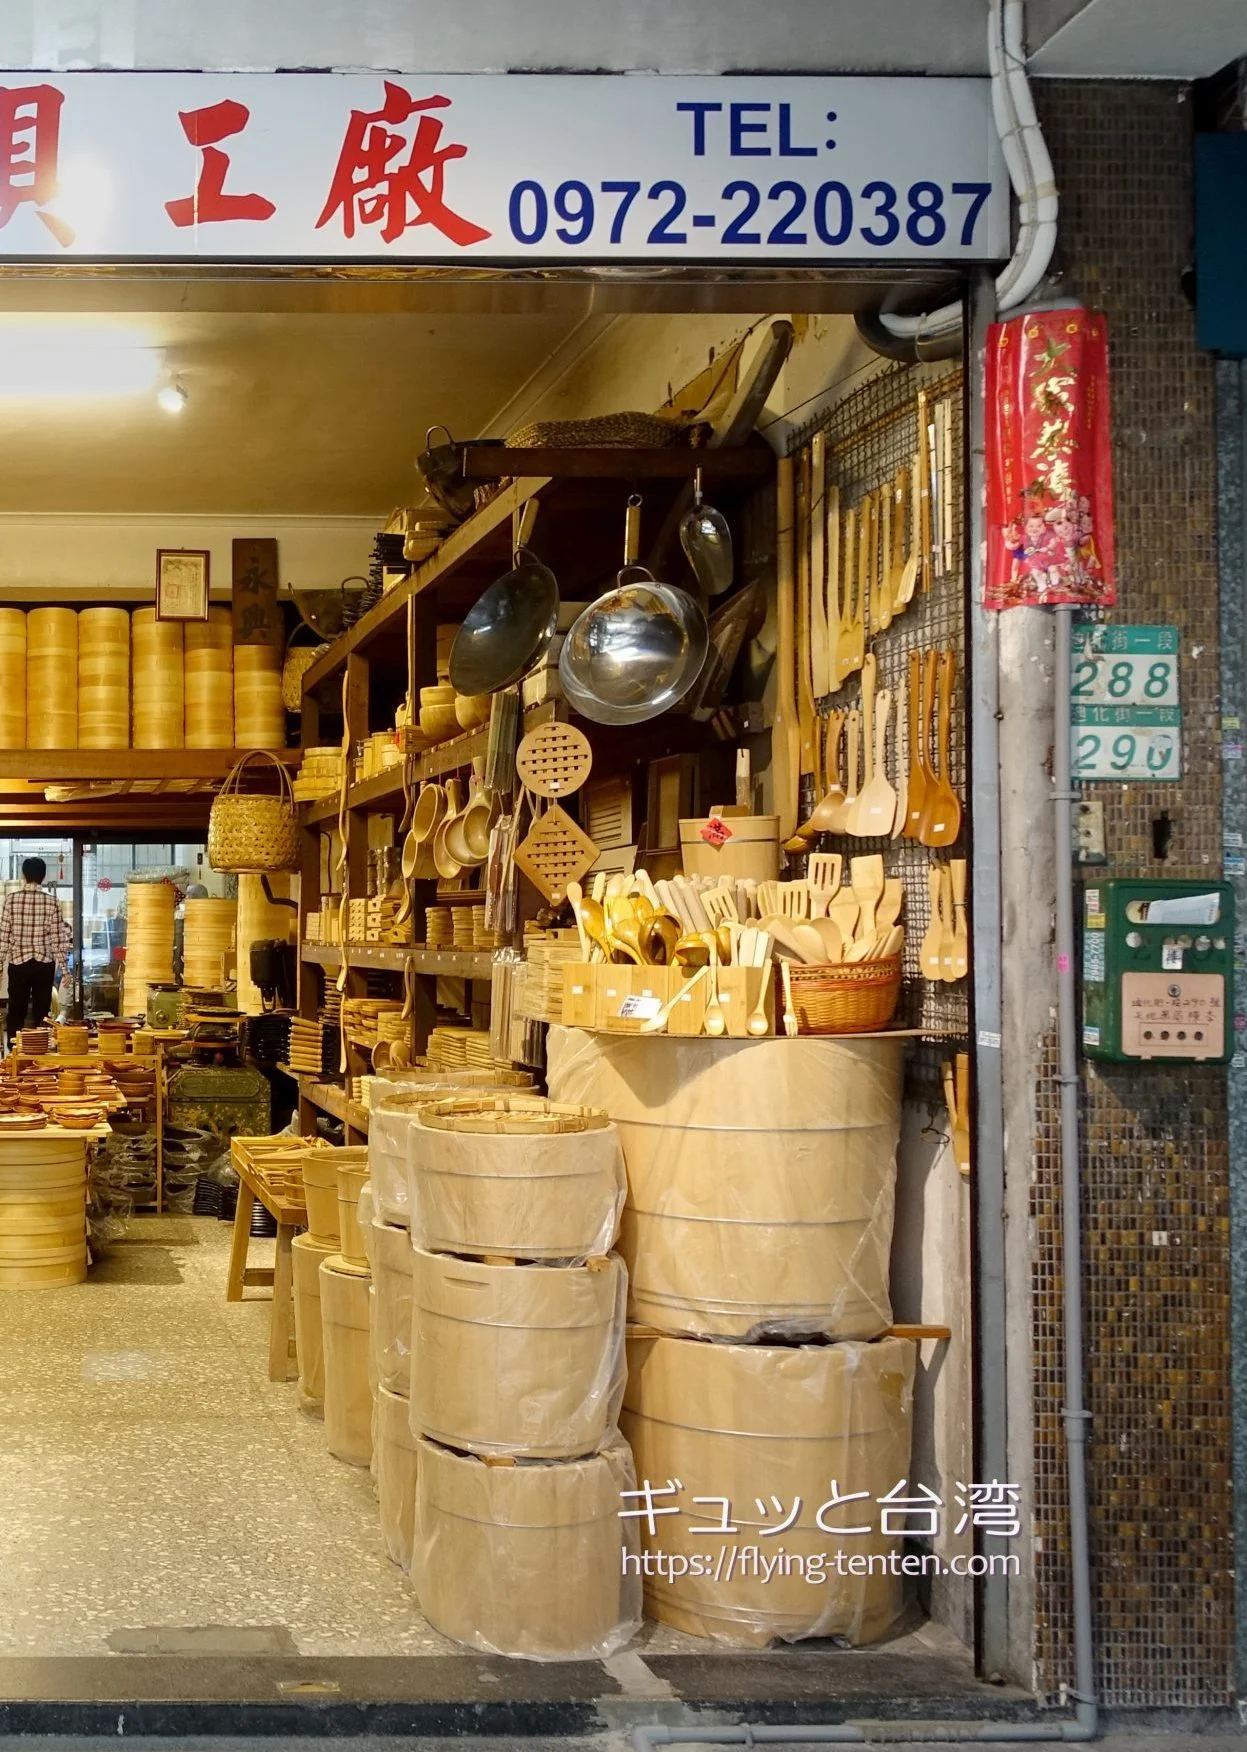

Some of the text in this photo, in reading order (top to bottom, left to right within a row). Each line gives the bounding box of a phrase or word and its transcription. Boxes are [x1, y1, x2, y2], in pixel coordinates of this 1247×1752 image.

[509, 180, 992, 245] 0972-220387
[1072, 630, 1173, 650] 街一段
[1071, 661, 1172, 699] 288
